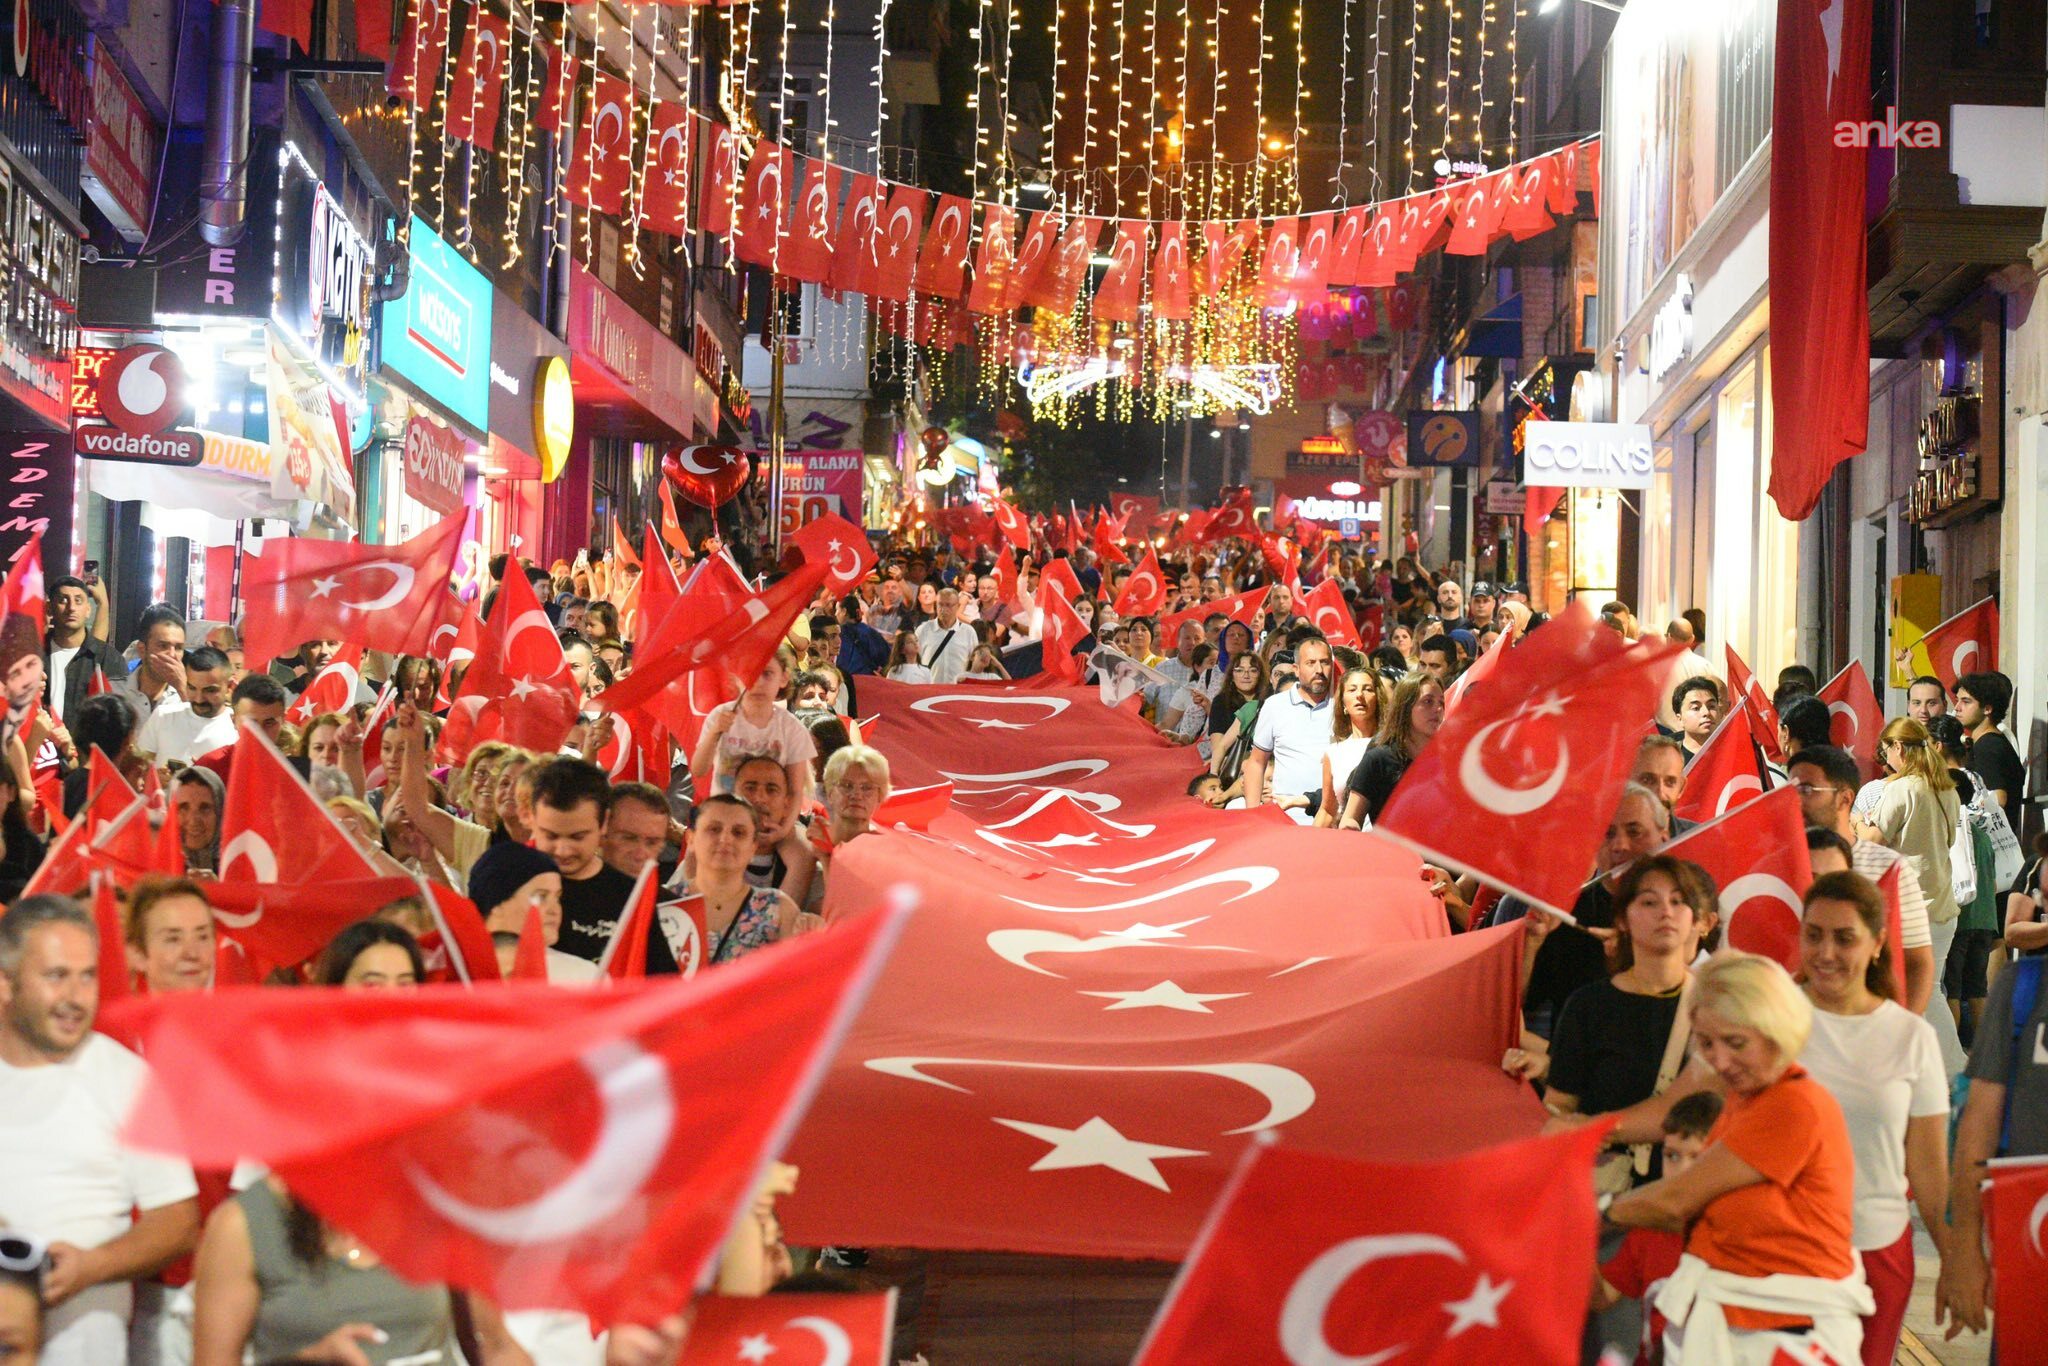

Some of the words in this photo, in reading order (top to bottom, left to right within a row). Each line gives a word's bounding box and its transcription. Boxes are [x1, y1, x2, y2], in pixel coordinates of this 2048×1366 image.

[84, 432, 191, 458] vodafone
[1530, 438, 1651, 475] COLIN'S
[808, 456, 859, 470] ALANA
